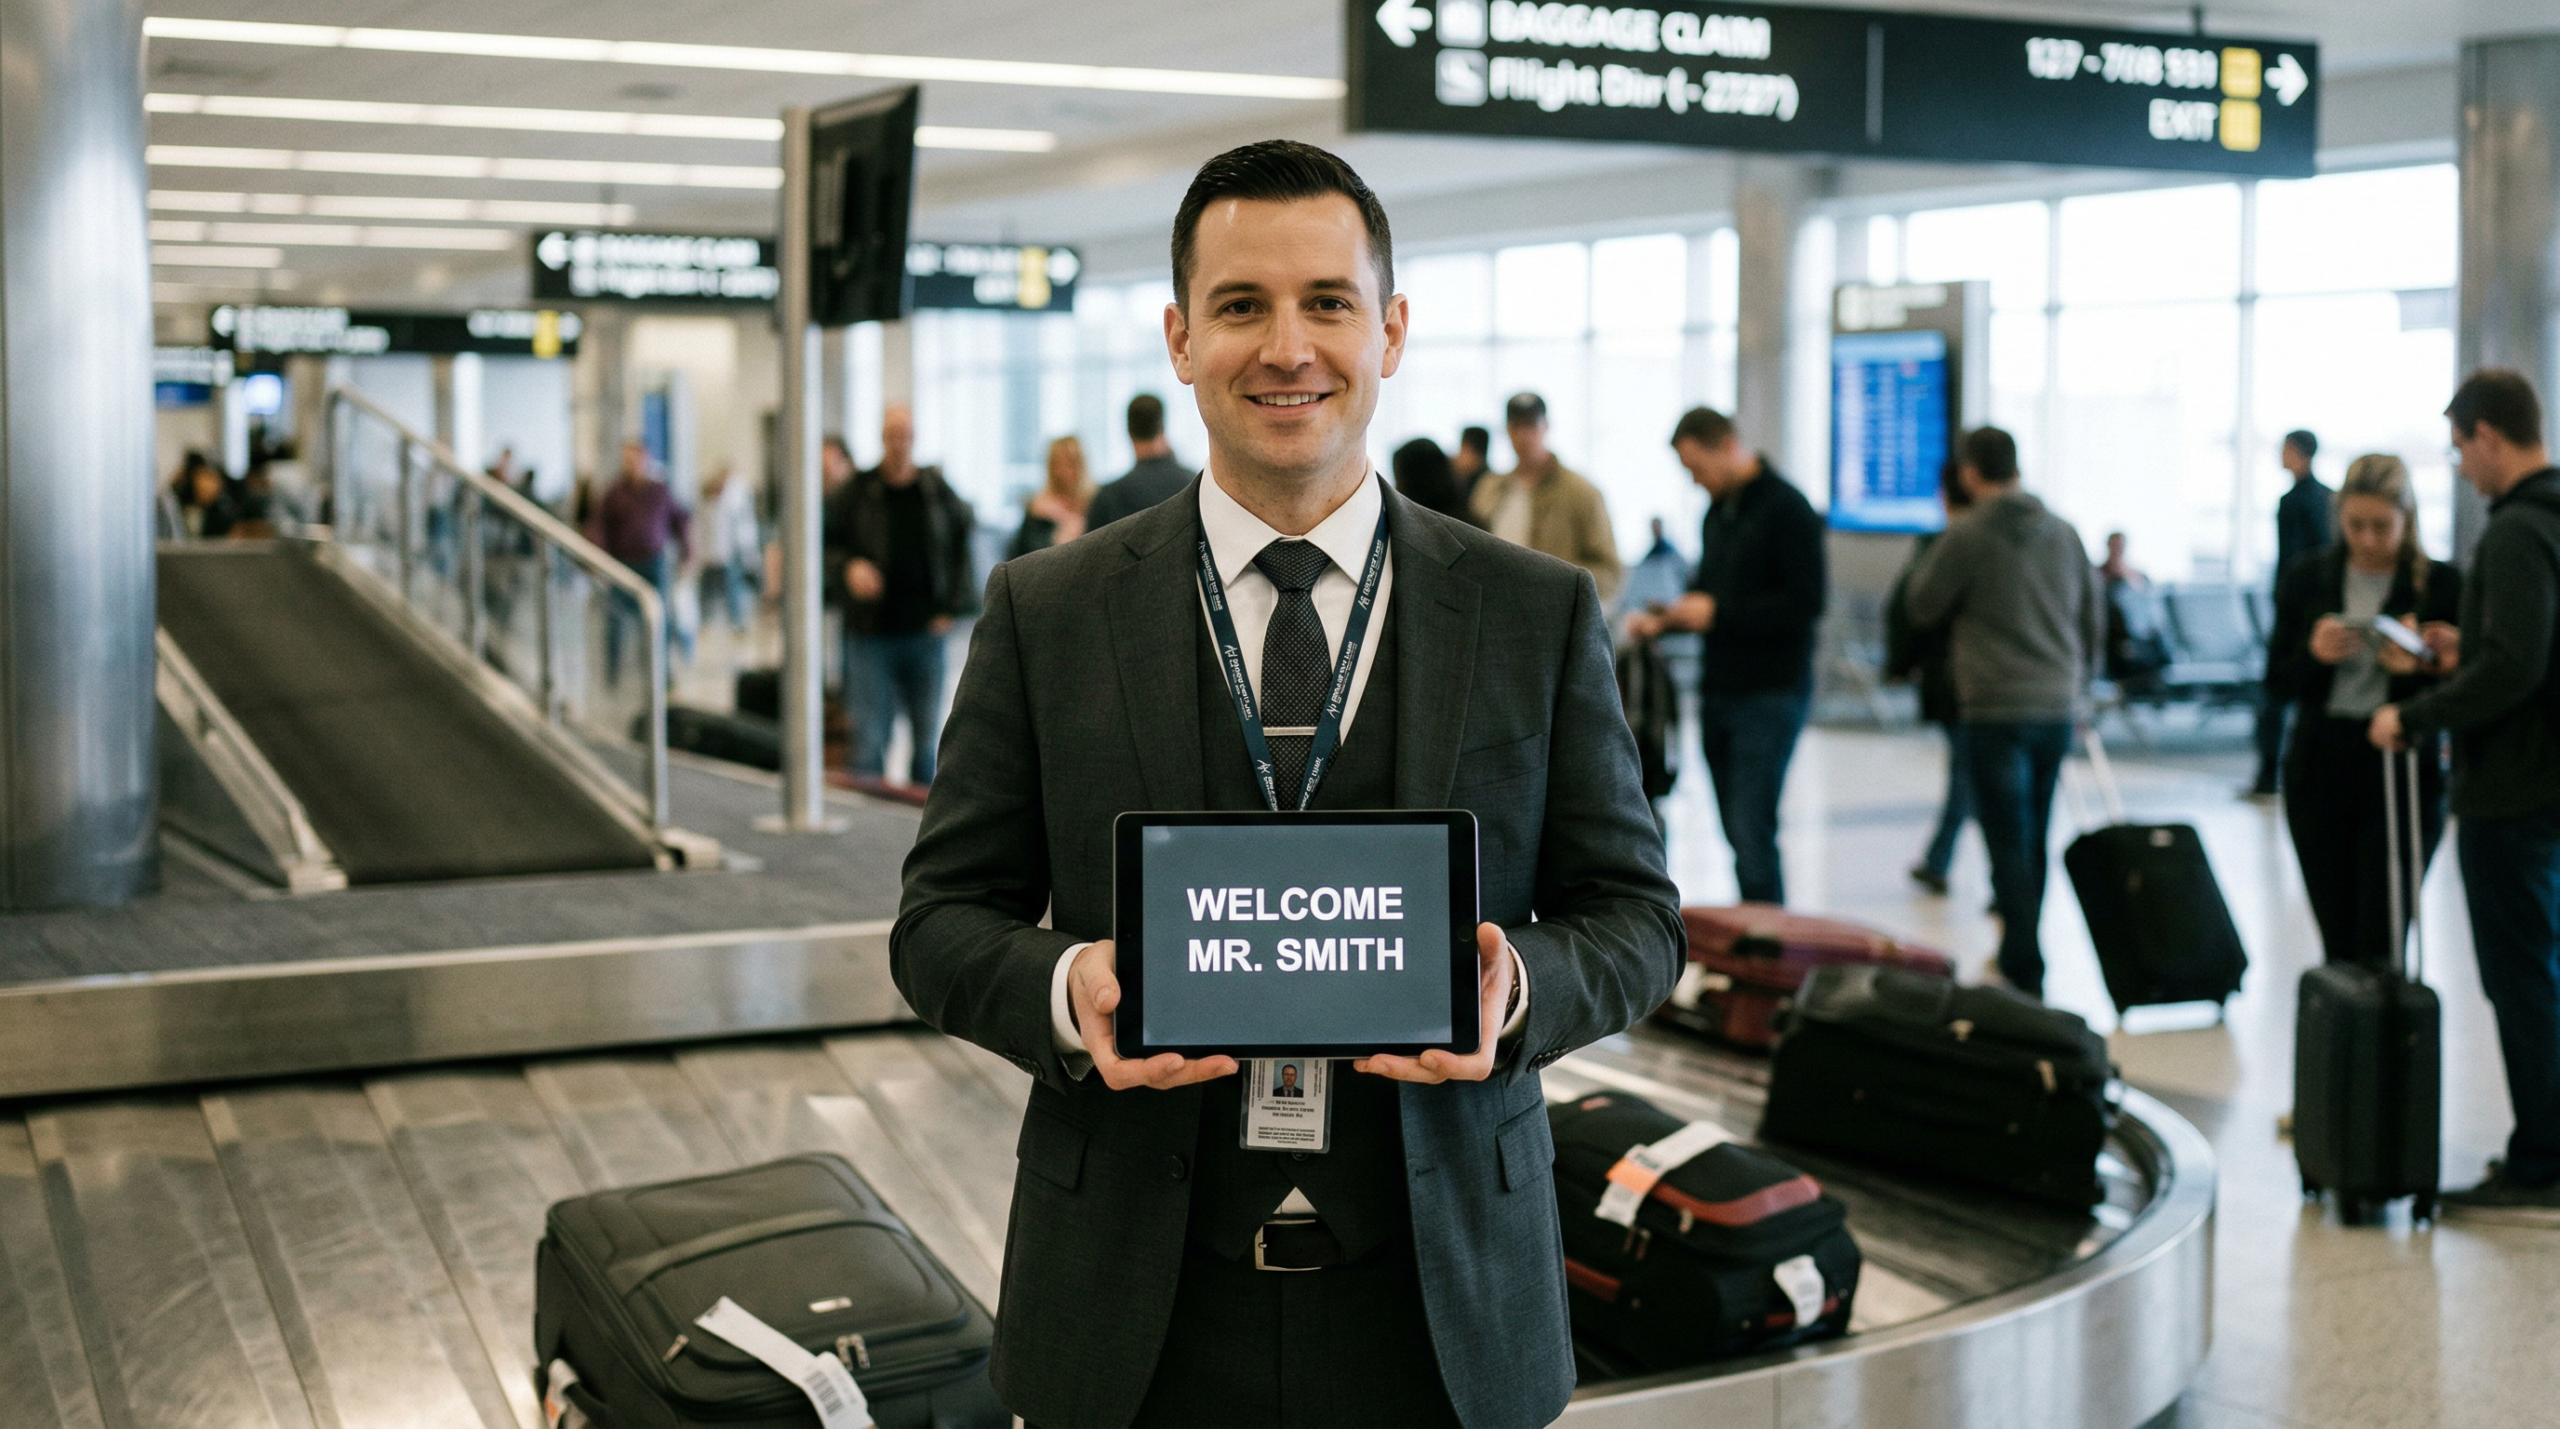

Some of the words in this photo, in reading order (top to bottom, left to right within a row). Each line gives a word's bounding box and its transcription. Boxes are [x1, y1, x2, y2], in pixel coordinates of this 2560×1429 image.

[1490, 1, 1660, 52] BAGGAGE
[1662, 11, 1771, 59] CLAIM
[2149, 99, 2218, 141] EXIT
[1187, 887, 1403, 921] WELCOME
[1189, 939, 1262, 971] MR.
[1277, 938, 1403, 971] SMITH
